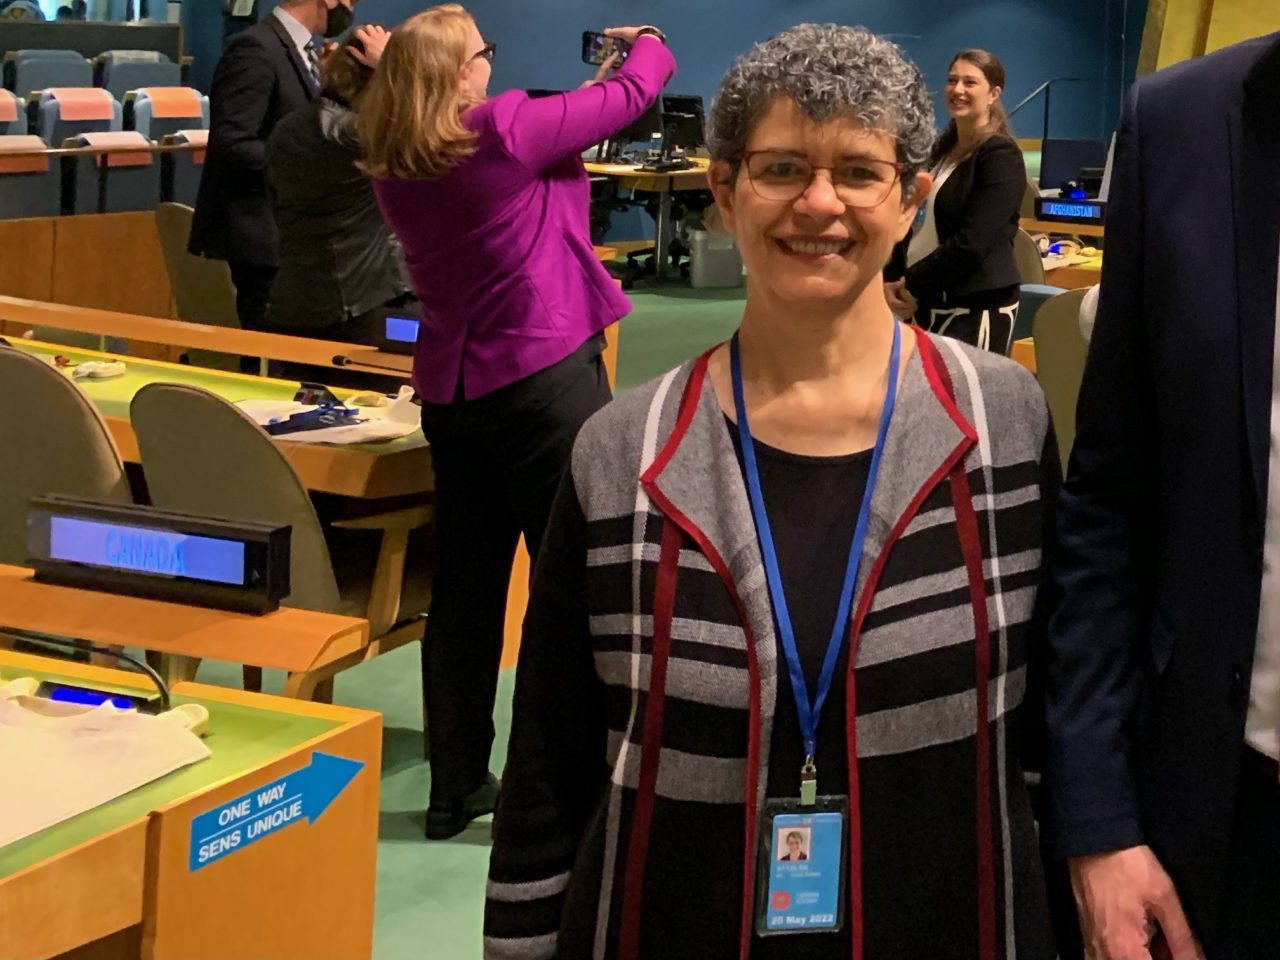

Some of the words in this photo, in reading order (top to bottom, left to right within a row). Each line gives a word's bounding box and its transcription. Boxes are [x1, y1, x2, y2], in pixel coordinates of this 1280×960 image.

[1050, 202, 1093, 218] AFGHANISTAN
[105, 528, 186, 575] CANADA
[218, 798, 252, 826] ONE
[256, 782, 287, 808] WAY
[198, 830, 241, 863] SENS
[247, 800, 303, 839] UNIQUE
[786, 915, 806, 926] May
